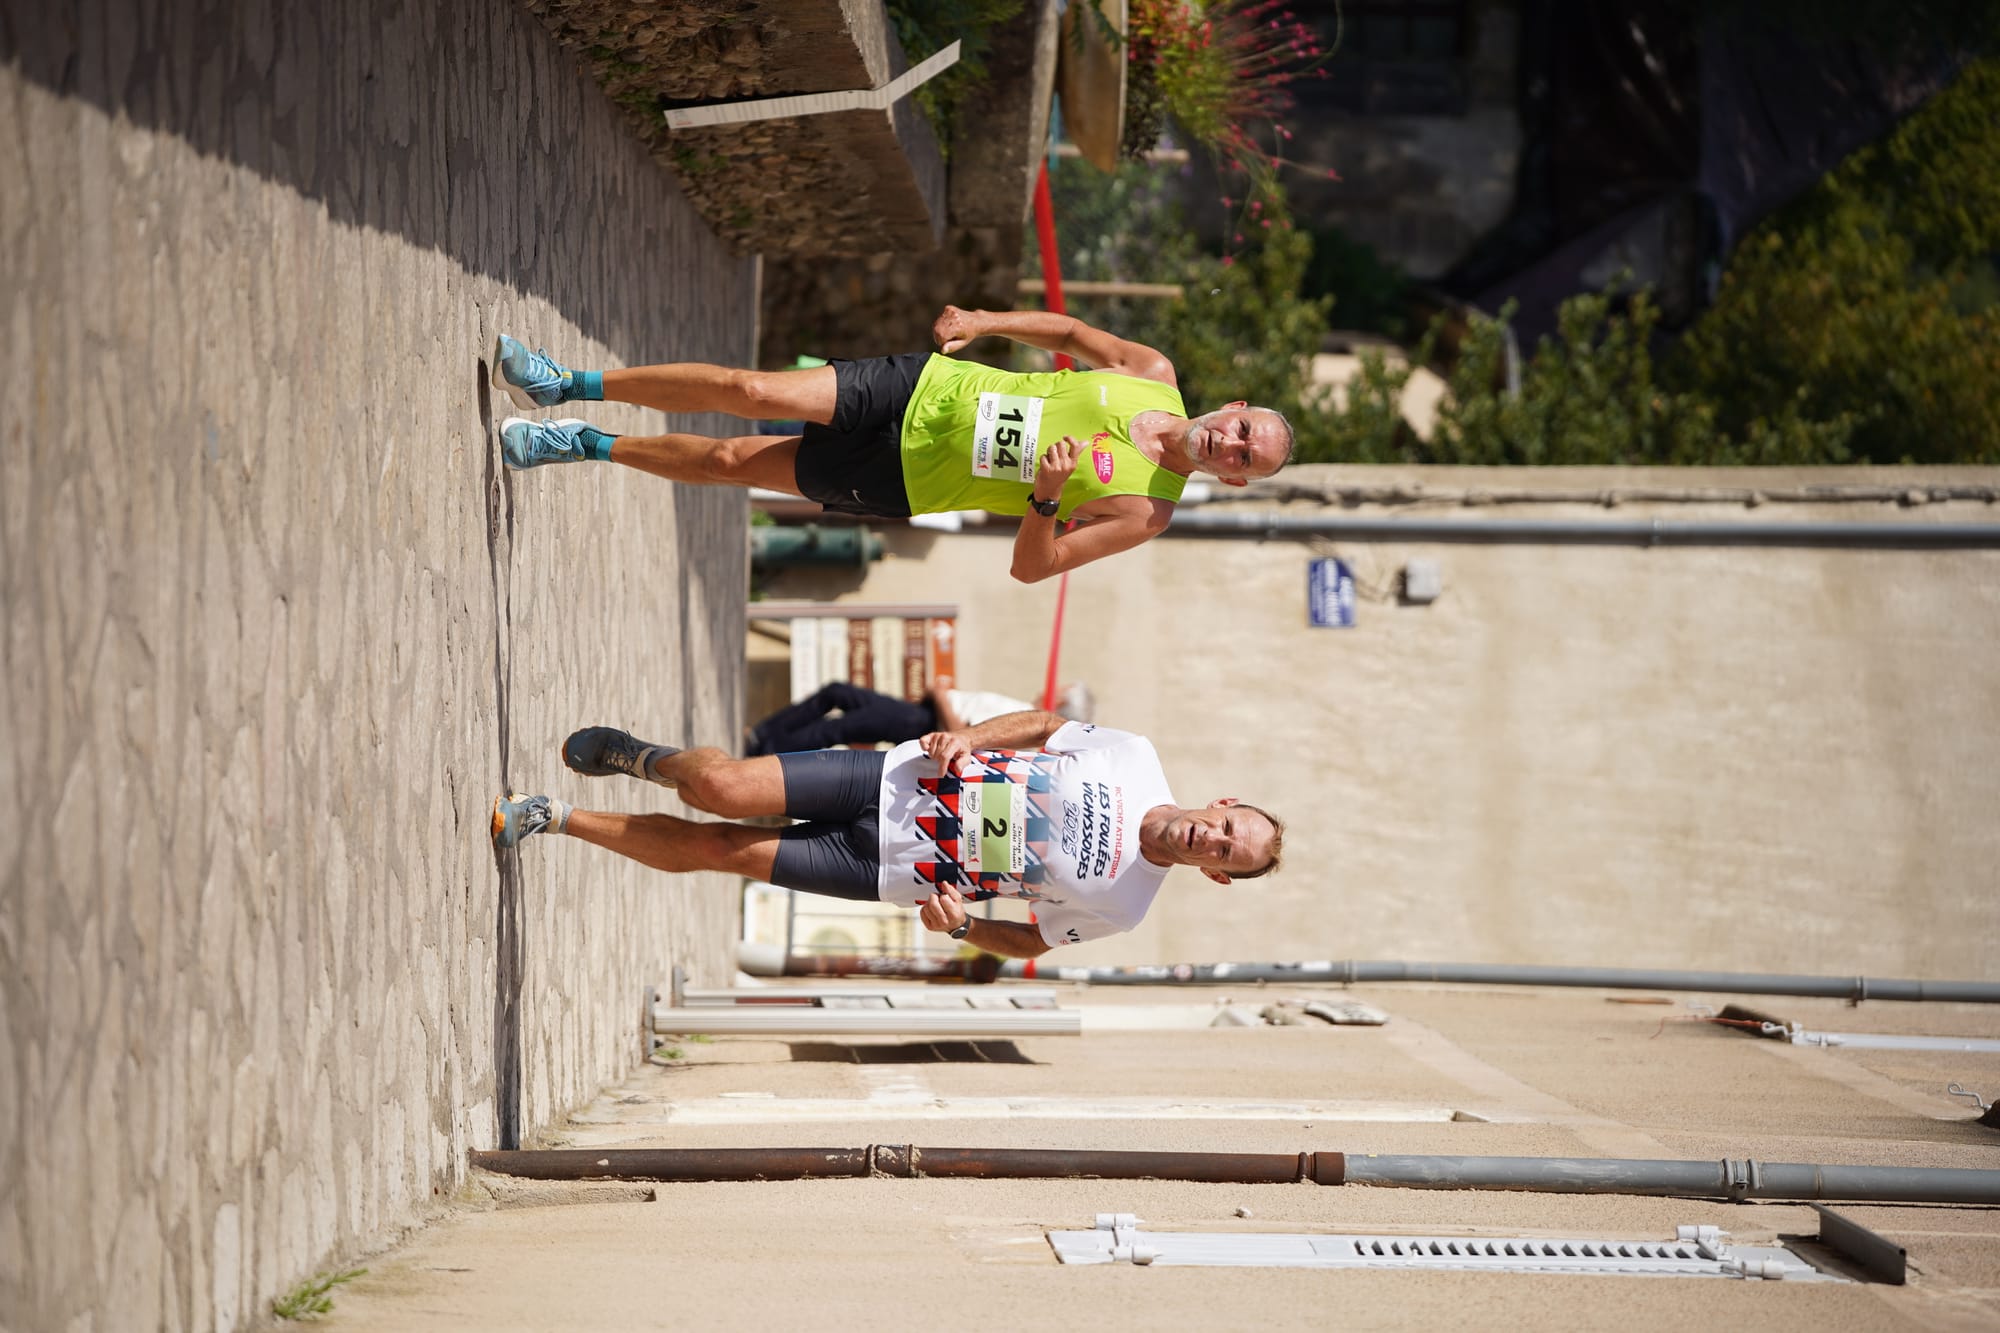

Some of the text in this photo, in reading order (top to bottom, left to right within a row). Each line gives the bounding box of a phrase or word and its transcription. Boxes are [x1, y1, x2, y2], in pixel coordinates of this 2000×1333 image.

[980, 436, 988, 462] TUFF'S
[994, 408, 1024, 469] 154
[1103, 454, 1112, 476] MARC
[983, 817, 1008, 838] 2
[1062, 800, 1080, 860] 2025
[1094, 782, 1111, 878] LES FOULÉES
[1116, 800, 1124, 824] VICHY
[1108, 826, 1122, 880] ATHLETISME
